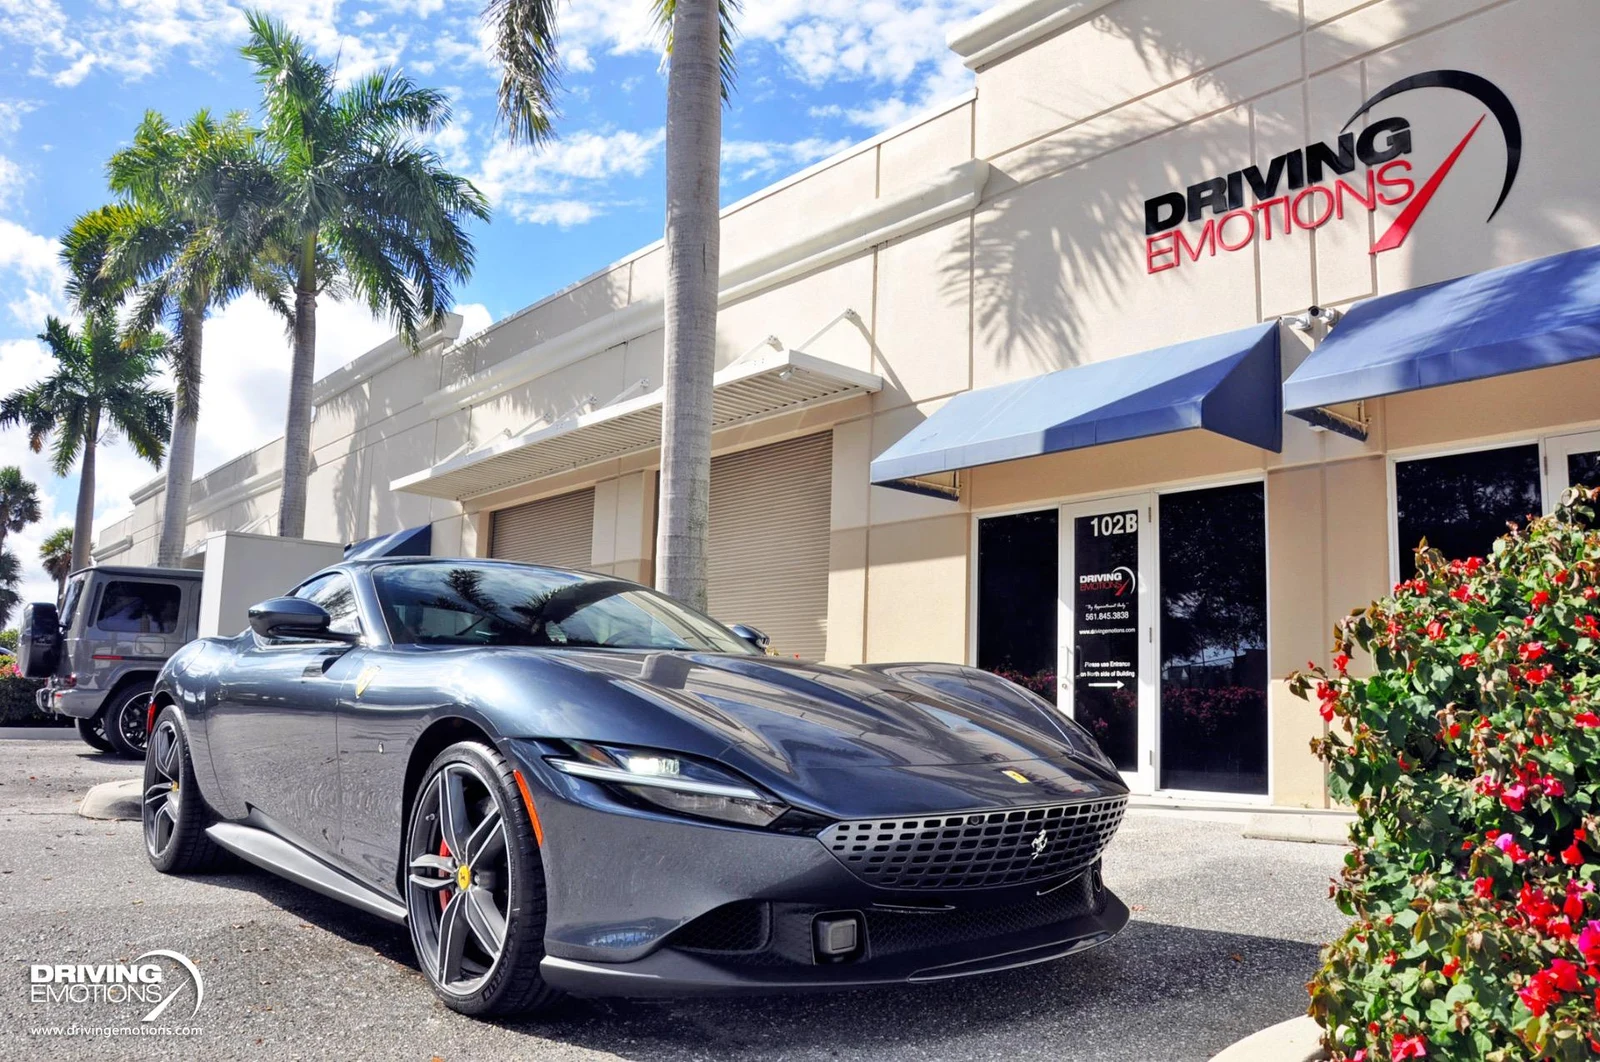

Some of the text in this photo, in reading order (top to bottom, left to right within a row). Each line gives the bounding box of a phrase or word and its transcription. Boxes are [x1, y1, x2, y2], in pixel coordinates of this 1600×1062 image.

[1145, 117, 1412, 235] DRIVING
[1146, 160, 1415, 274] EMOTIONS
[1090, 513, 1138, 537] 102B
[1080, 573, 1122, 583] DRIVING
[1080, 581, 1123, 591] EMOTIONS
[1085, 611, 1129, 620] 561.845.3838
